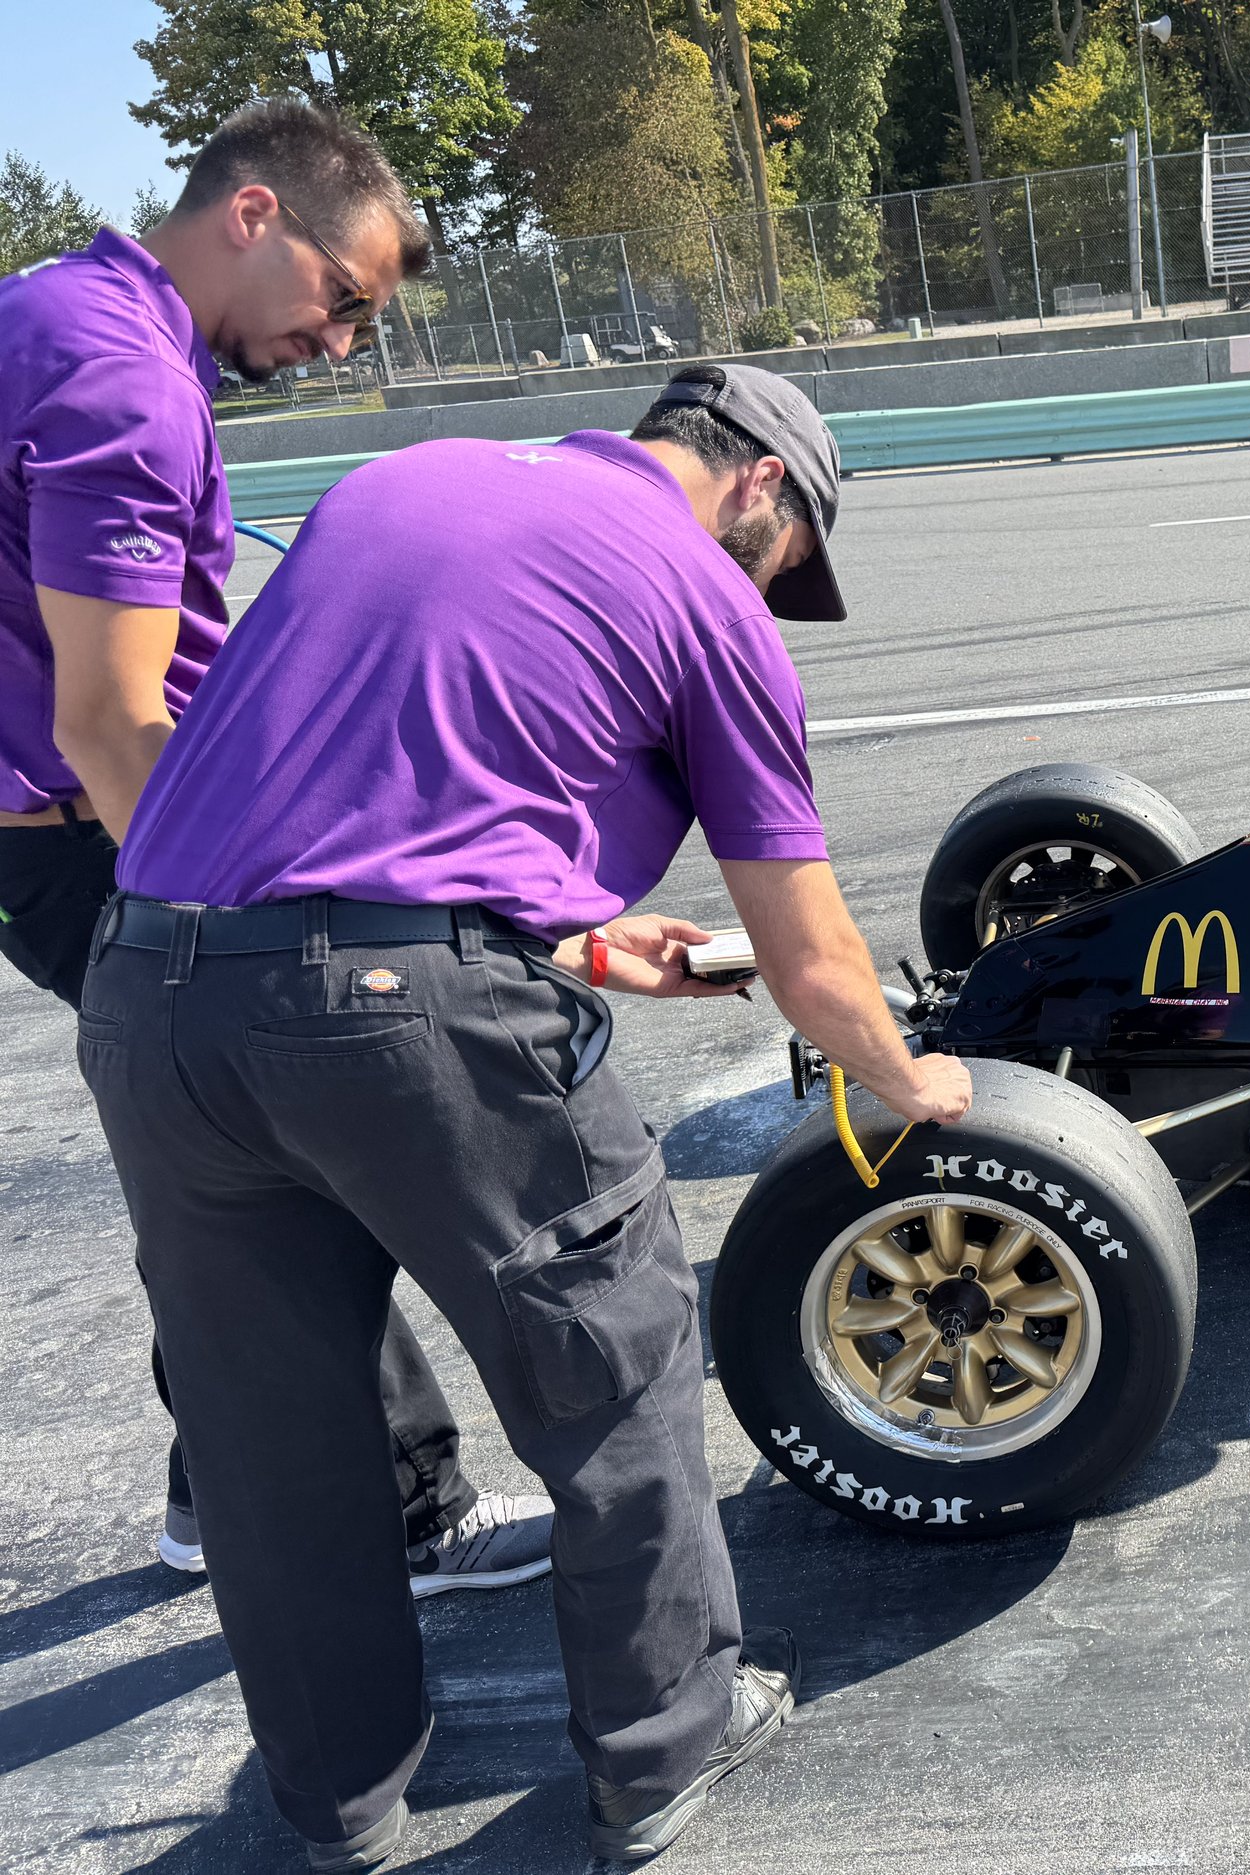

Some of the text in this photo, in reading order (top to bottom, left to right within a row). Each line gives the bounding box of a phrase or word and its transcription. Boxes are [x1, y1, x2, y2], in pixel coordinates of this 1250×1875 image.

[902, 1198, 945, 1209] PANASPORT
[987, 1203, 1014, 1216] RACING
[1015, 1214, 1047, 1236] PURPOSE
[1046, 1234, 1062, 1249] ONLY
